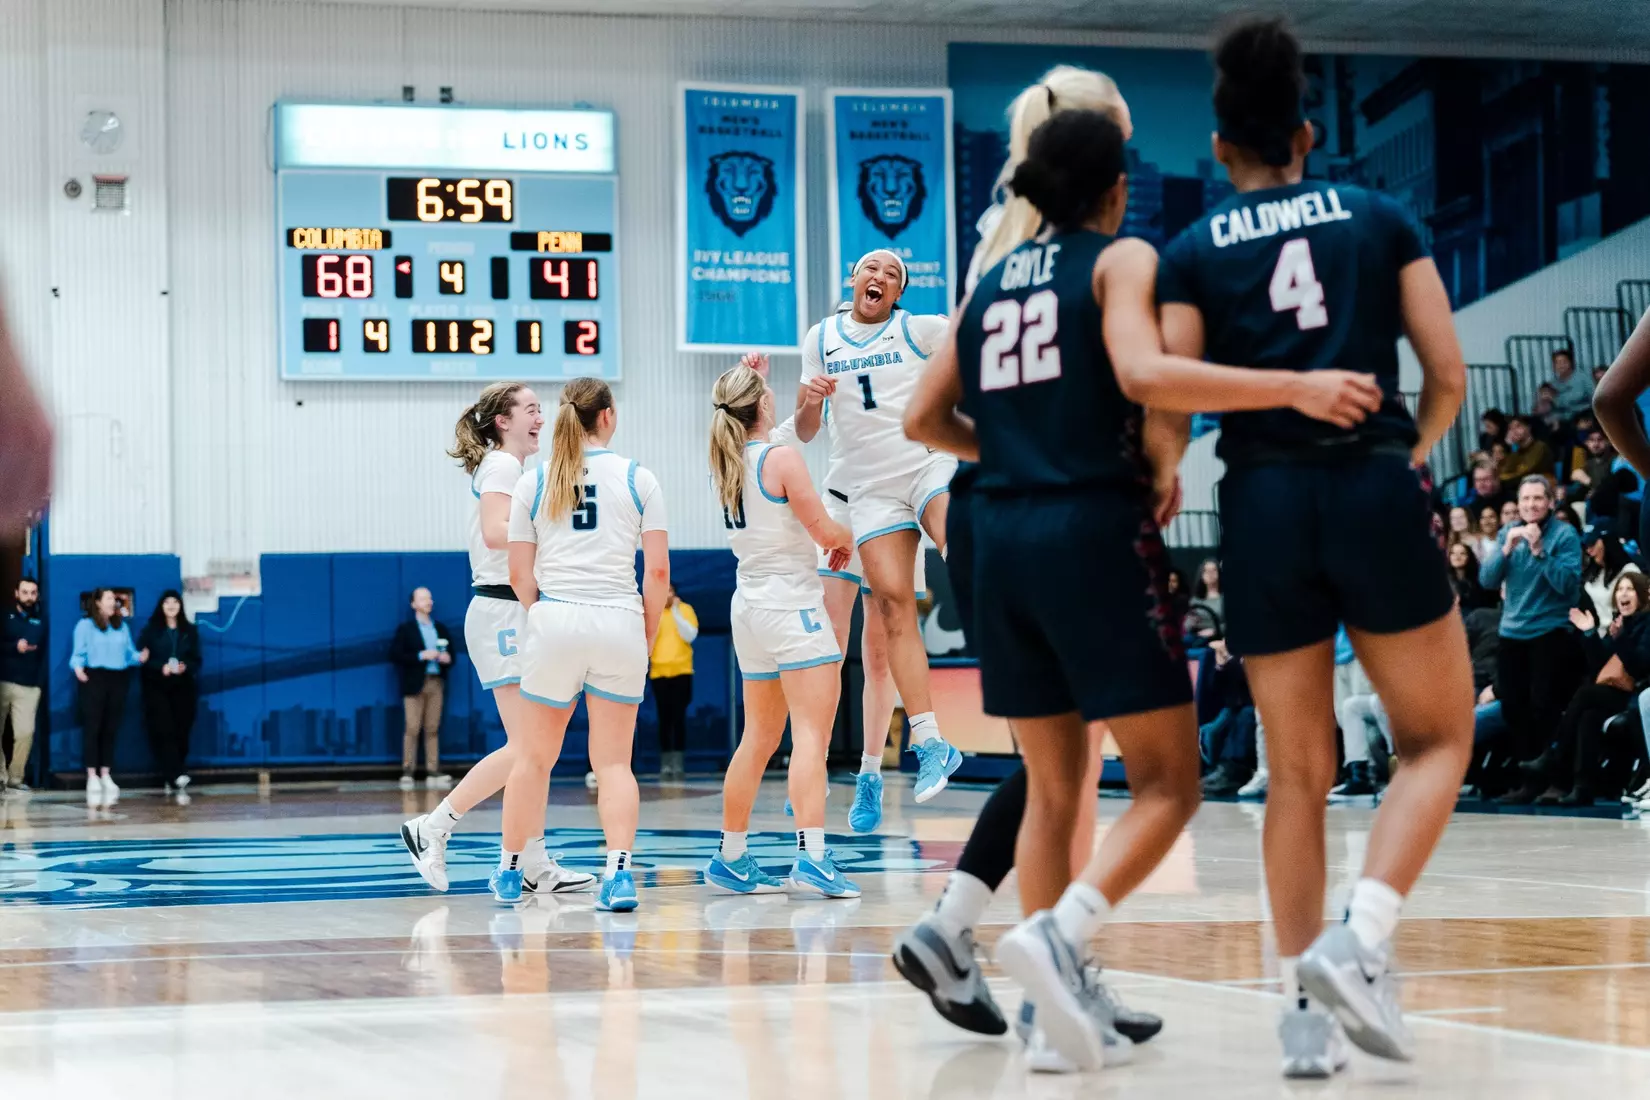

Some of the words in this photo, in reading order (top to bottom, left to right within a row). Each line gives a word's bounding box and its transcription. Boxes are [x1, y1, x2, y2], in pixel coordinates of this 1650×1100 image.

[503, 131, 589, 151] LIONS
[417, 177, 512, 222] 6:59
[1209, 187, 1353, 248] CALDWELL
[293, 227, 383, 250] COLUMBIA
[537, 231, 583, 253] PENN
[693, 249, 721, 264] IVY
[723, 250, 790, 267] LEAGUE
[316, 255, 373, 298] 68
[440, 262, 464, 294] 4
[543, 260, 598, 299] 41
[692, 266, 792, 284] CHAMPIONS
[1269, 237, 1329, 331] 4
[328, 319, 338, 351] 1
[364, 320, 388, 352] 4
[530, 321, 541, 353] 1
[576, 320, 598, 355] 2
[980, 289, 1062, 392] 22
[826, 351, 903, 374] COLUMBIA
[857, 373, 878, 411] 1
[571, 484, 599, 531] 5
[497, 628, 518, 656] C
